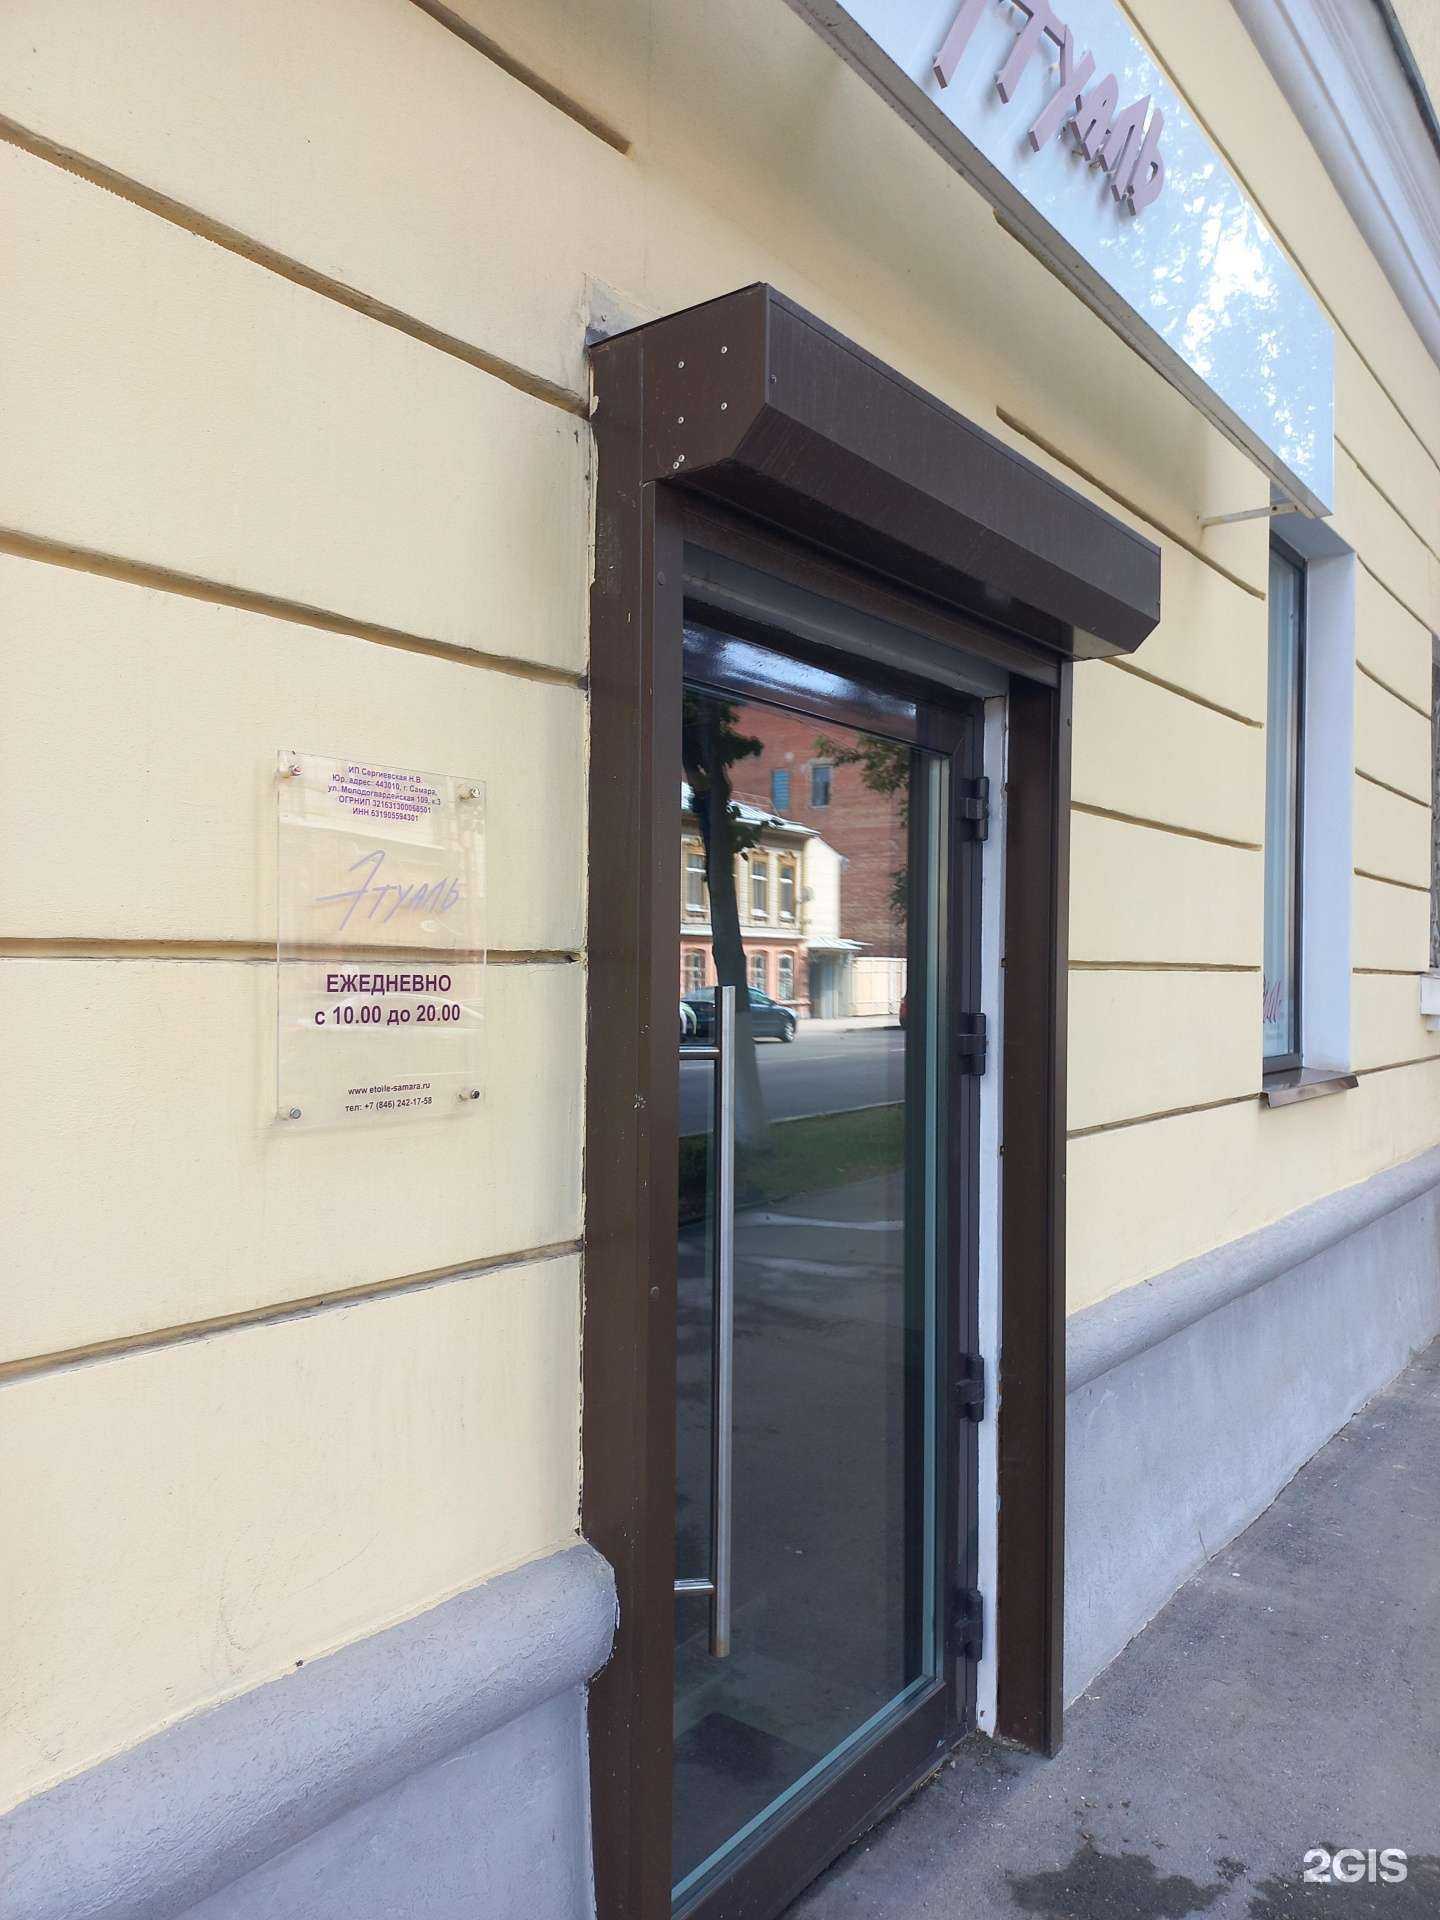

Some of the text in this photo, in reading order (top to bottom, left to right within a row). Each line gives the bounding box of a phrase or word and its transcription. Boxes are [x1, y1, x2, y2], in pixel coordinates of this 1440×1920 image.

[348, 766, 360, 774] ИП
[338, 795, 371, 806] ОГРНИП
[352, 807, 370, 816] ИНН
[325, 974, 452, 996] ЕЖЕДНЕВНО
[314, 1003, 461, 1026] с 10.00 до 20.00
[364, 1101, 374, 1110] +7
[376, 1099, 395, 1111] (846)
